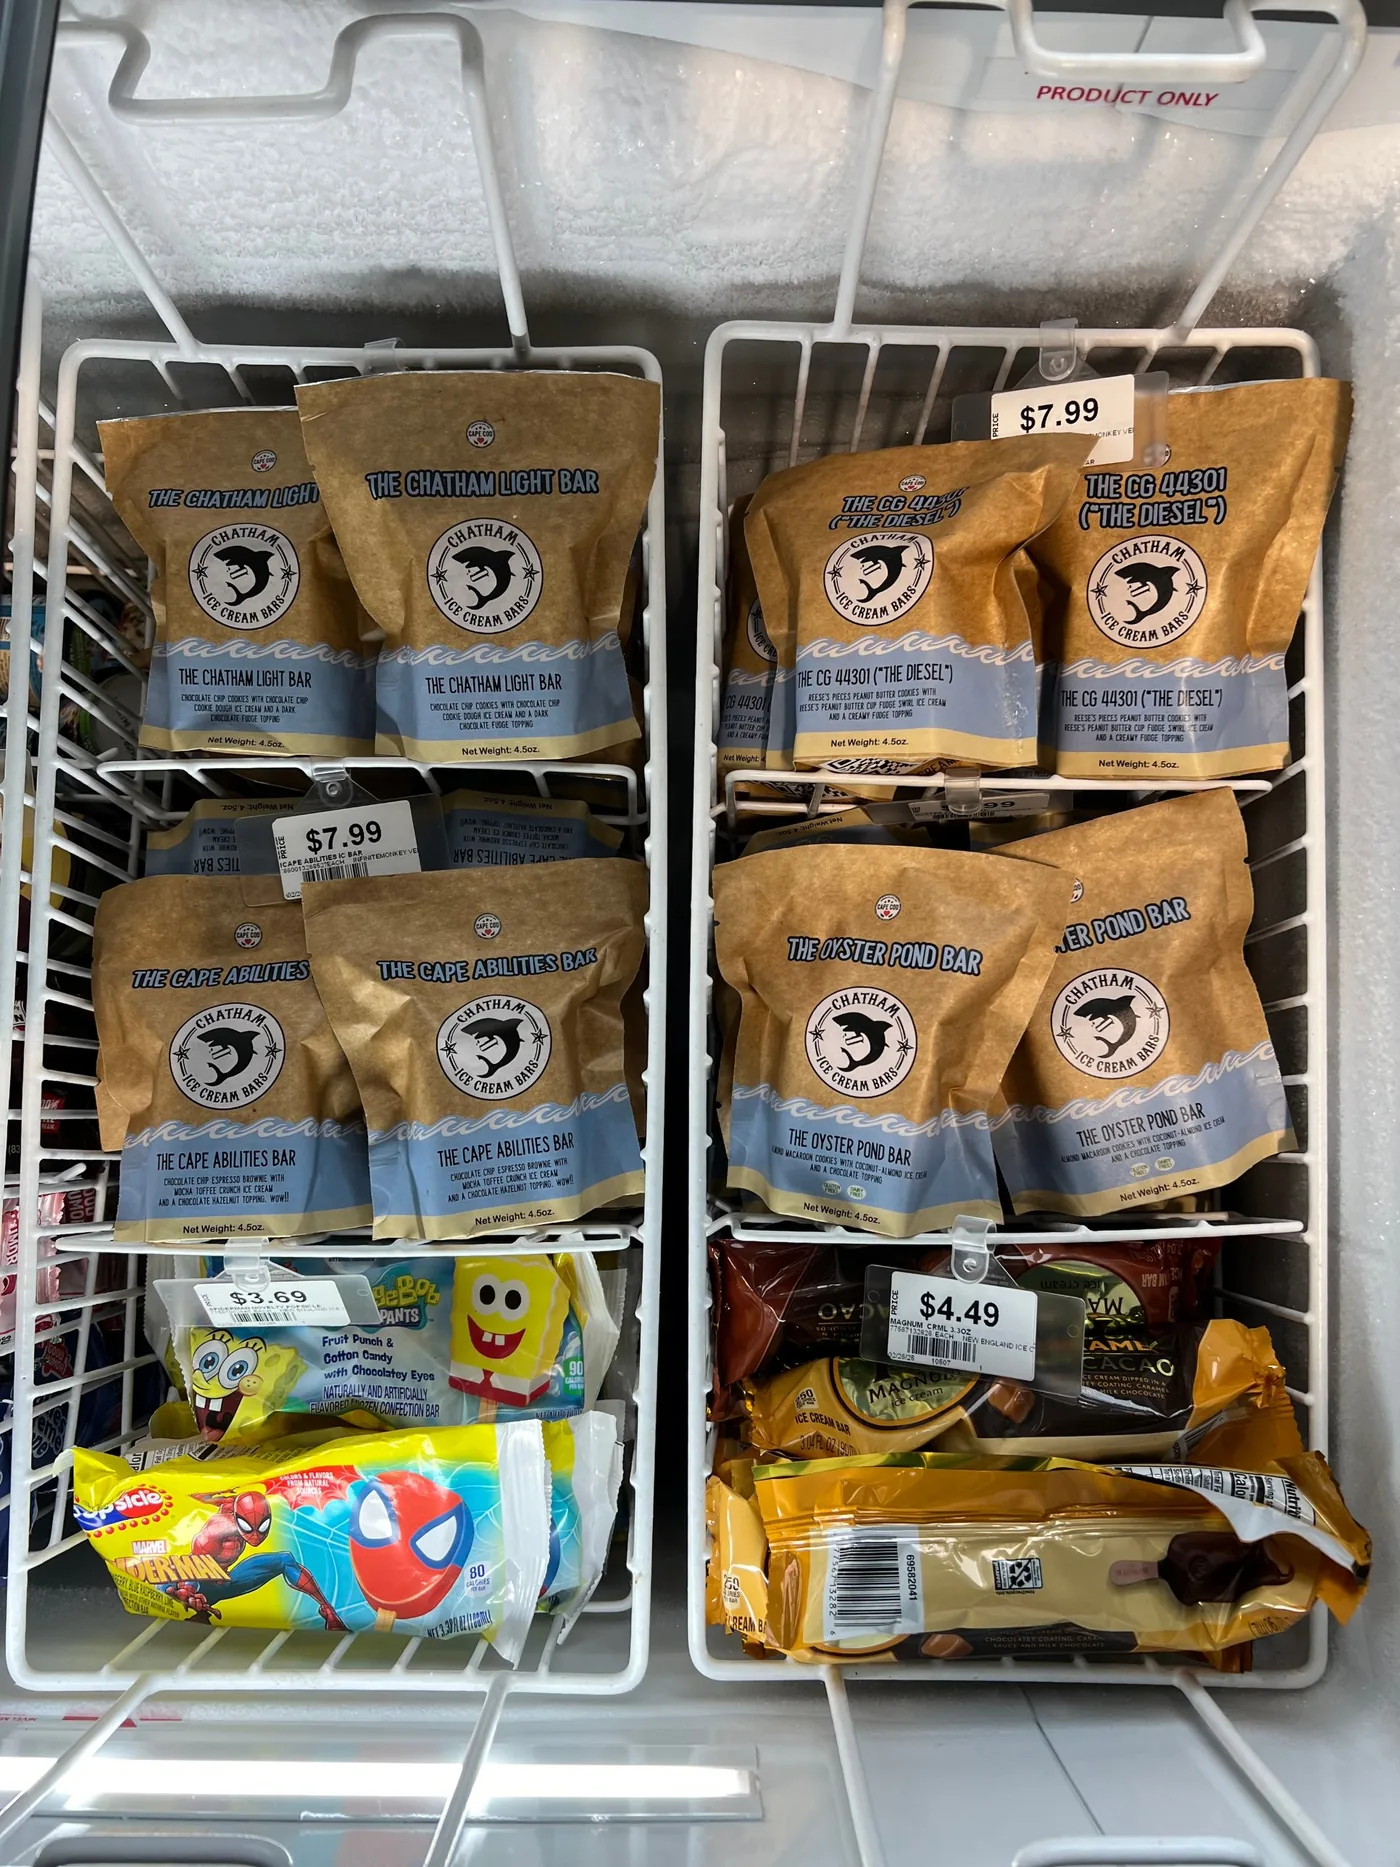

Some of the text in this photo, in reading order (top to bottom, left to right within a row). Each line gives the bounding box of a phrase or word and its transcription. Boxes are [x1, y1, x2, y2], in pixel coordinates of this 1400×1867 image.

[1036, 83, 1219, 107] PRODUCT ONLY
[1020, 398, 1098, 433] $7.99
[365, 468, 599, 500] THE CHATHAM LIGHT BAR
[1085, 467, 1227, 499] THE CG 44301
[149, 489, 183, 508] THE
[185, 489, 271, 508] CHATHAM
[842, 495, 877, 513] THE
[877, 495, 907, 512] CG
[1079, 496, 1227, 530] ("THE DIESEL")
[448, 524, 518, 548] CHATHAM
[1112, 540, 1186, 564] CHATHAM
[444, 595, 529, 627] ICE CREAM BARS
[1101, 611, 1189, 641] ICE CREAM BARS
[179, 668, 311, 688] THE CHATHAM LIGHT BAR
[426, 673, 562, 694] THE CHATHAM LIGHT BAR
[798, 664, 953, 688] THE CG 44301 ("THE DIESEL")
[430, 699, 560, 711] CHOCOLATE CHIP COOKIES WITH CHOCOLATE CHIP
[1061, 689, 1222, 708] THE CG 44301 ("THE DIESEL")
[443, 712, 461, 720] COOKIE
[464, 712, 481, 720] DOUGH
[495, 711, 512, 719] CREAM
[460, 720, 533, 730] CHOCOLATE FUDGE TOPPING
[480, 747, 512, 756] Weight:
[279, 836, 287, 859] PRICE
[306, 821, 381, 854] $7.99
[304, 850, 362, 865] ABILITIES IC BAR
[353, 850, 407, 863] INFINITEMONKEY
[1091, 910, 1145, 944] POND
[1145, 897, 1191, 928] BAR
[377, 947, 597, 983] THE CAPE ABILITIES BAR
[788, 936, 983, 976] THE OYSTER POND BAR
[133, 960, 311, 989] THE CAPE ABILITIES
[832, 993, 900, 1018] CHATHAM
[817, 1056, 898, 1091] ICE CREAM BARS
[1076, 1103, 1205, 1147] THE OYSTER POND BAR
[438, 1132, 574, 1167] THE CAPE ABILITIES BAR
[789, 1129, 911, 1166] THE OYSTER POND BAR
[157, 1149, 296, 1170] THE CAPE ABILITIES BAR
[1120, 1178, 1199, 1201] Net Weight: 4.5oz.
[230, 1291, 307, 1305] $3.69
[891, 1290, 899, 1315] PRICE
[920, 1291, 999, 1327] $4.49
[890, 1318, 923, 1328] MAGNUM
[927, 1323, 947, 1332] CRML
[322, 1334, 394, 1347] Fruit Punch &
[963, 1336, 979, 1344] NEW
[981, 1338, 1013, 1349] ENGLAND
[1016, 1344, 1027, 1352] ICE
[324, 1350, 393, 1364] Cotton Candy
[569, 1361, 583, 1375] 90
[1083, 1356, 1174, 1376] CACAO
[324, 1365, 435, 1382] with Chocolatey Eyes
[323, 1384, 428, 1400] NATURALLY AND ARTIFICIALLY
[891, 1387, 943, 1408] ice cream
[311, 1399, 348, 1414] FLAVORED
[379, 1403, 424, 1417] CONFECTION
[426, 1403, 439, 1418] BAR
[795, 1412, 851, 1435] ICE CREAM BAR
[133, 1541, 167, 1554] MARVEL
[470, 1564, 485, 1579] 80
[906, 1554, 917, 1600] 69582041
